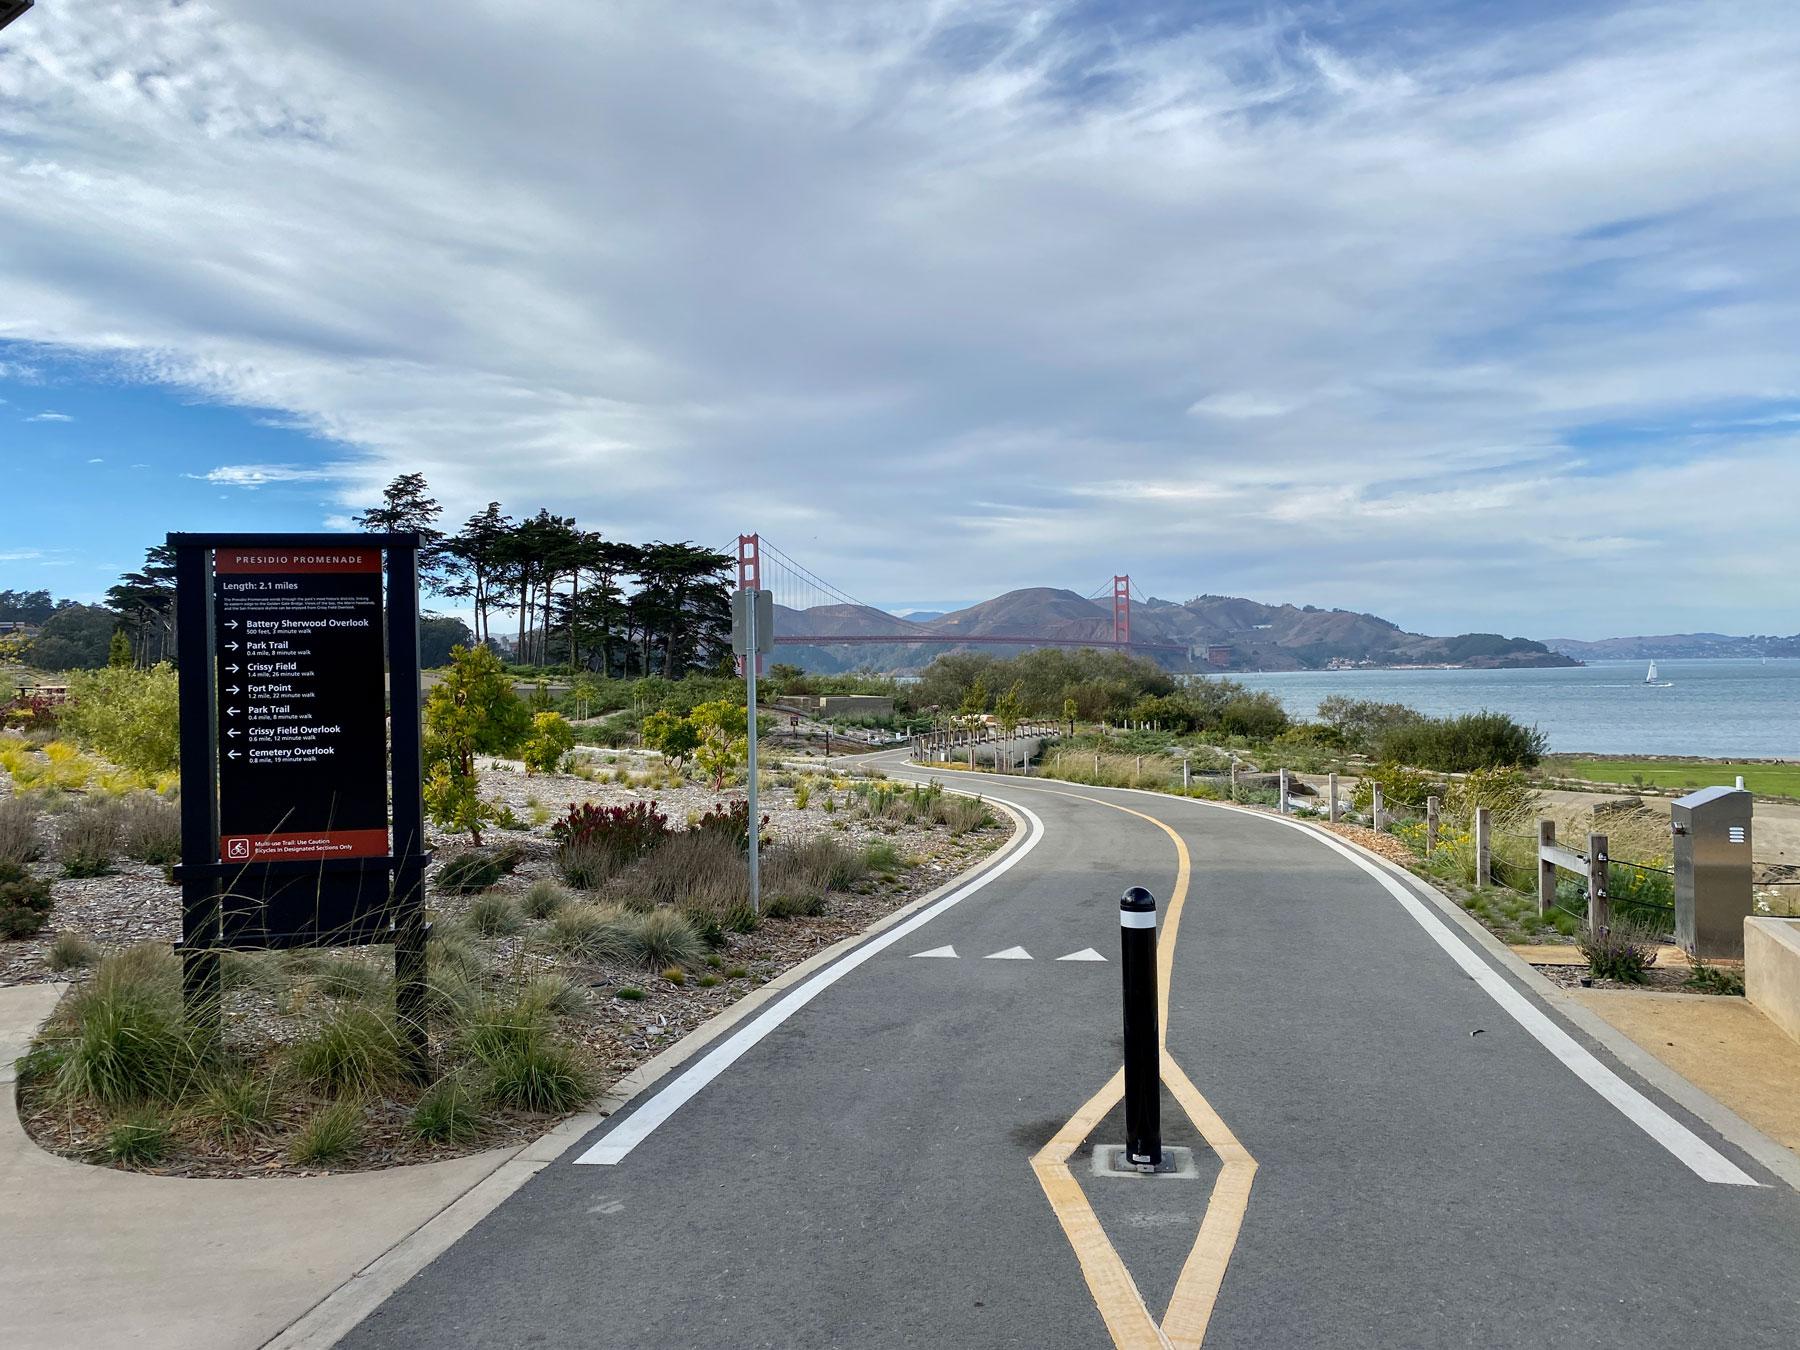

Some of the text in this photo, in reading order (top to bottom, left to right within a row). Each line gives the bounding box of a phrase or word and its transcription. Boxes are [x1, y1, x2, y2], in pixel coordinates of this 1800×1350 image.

[236, 556, 362, 564] PRESIDIO PROMENADE
[223, 581, 298, 592] Length: 2.1 miles
[247, 618, 369, 629] Battery Sherwood Overlook
[247, 640, 289, 649] Park Trail
[247, 661, 297, 673] Crissy Field
[248, 683, 292, 692] Fort Point
[248, 704, 290, 714] Park Trail
[248, 725, 341, 737] Crissy Field Overlook
[249, 746, 335, 758] Cemetery Overlook
